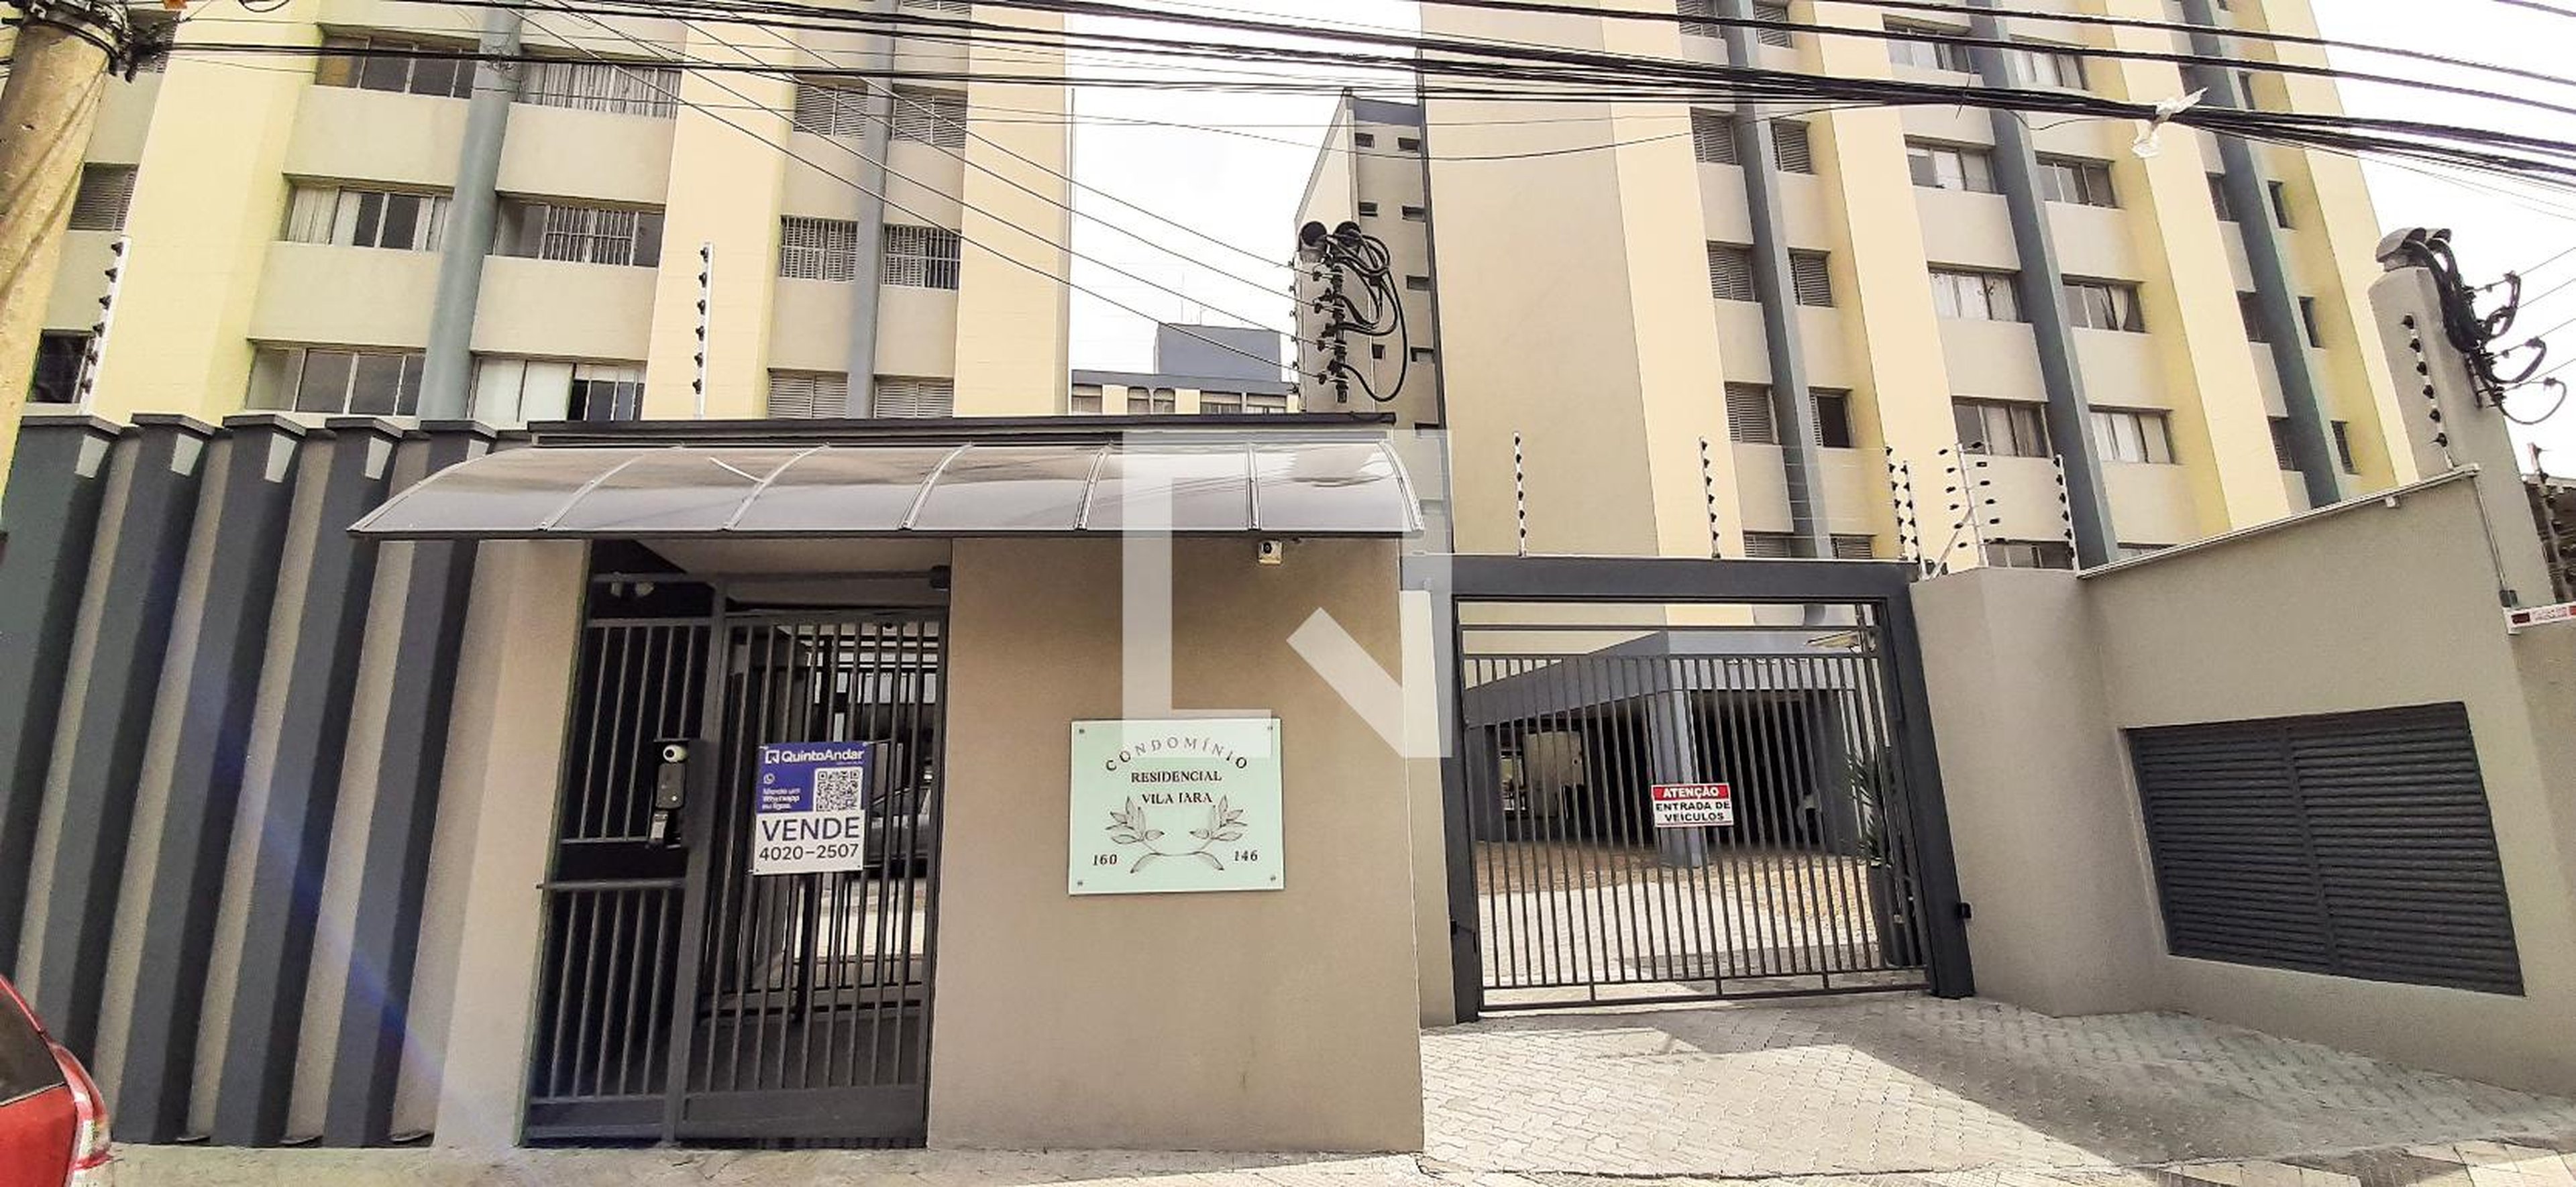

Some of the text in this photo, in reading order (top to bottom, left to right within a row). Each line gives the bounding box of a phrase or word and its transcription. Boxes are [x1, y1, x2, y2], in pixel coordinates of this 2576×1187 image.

[782, 748, 864, 763] QuintoAndar
[1106, 736, 1248, 771] CONDOMÍNIO
[1131, 770, 1222, 783] RESIDENCIAL
[1141, 792, 1213, 805] VILA IARA
[1663, 786, 1719, 799] ATENÇÃO
[1656, 801, 1731, 811] ENTRADA DE
[761, 817, 861, 842] VENDE
[759, 844, 859, 860] 4020-2507
[1234, 850, 1258, 862] 146
[1092, 854, 1118, 866] 160
